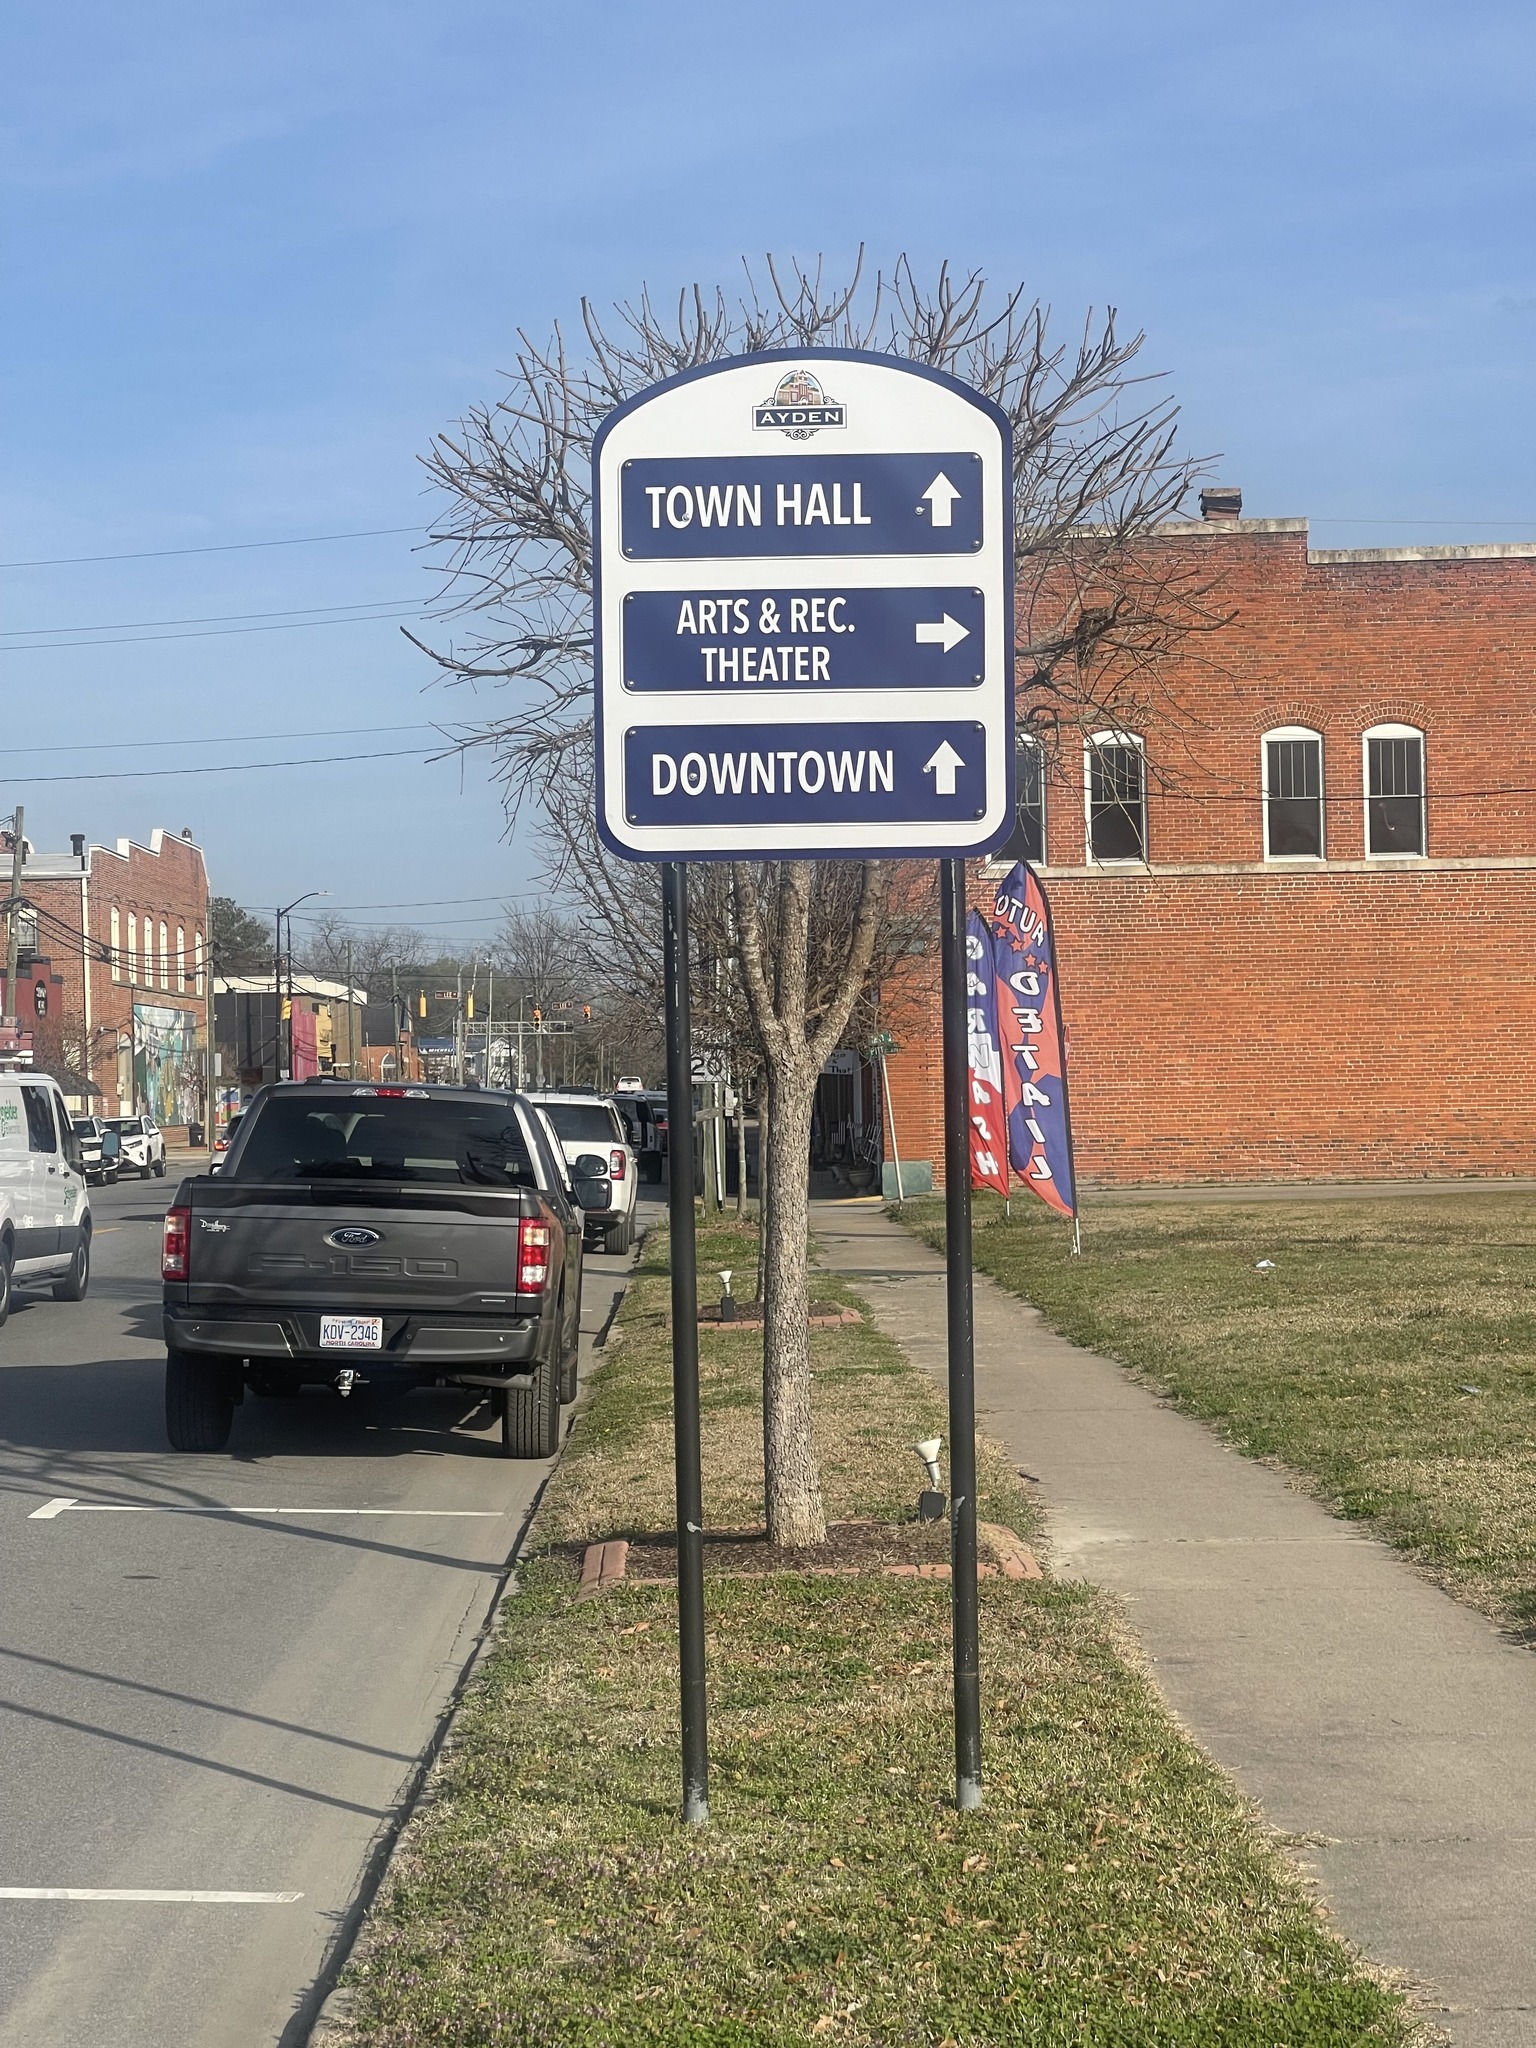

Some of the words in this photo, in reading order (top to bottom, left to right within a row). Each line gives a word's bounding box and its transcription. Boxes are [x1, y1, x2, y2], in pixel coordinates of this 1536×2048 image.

[760, 411, 839, 424] AYDEN
[645, 484, 761, 529] TOWN
[776, 482, 871, 526] HALL
[676, 598, 750, 635] ARTS
[758, 597, 781, 634] &
[790, 596, 856, 634] REC.
[701, 646, 831, 682] THEATER
[652, 750, 894, 796] DOWNTOWN
[341, 1231, 368, 1243] Ford
[248, 1253, 458, 1278] F-150
[323, 1324, 378, 1341] KDV-2346
